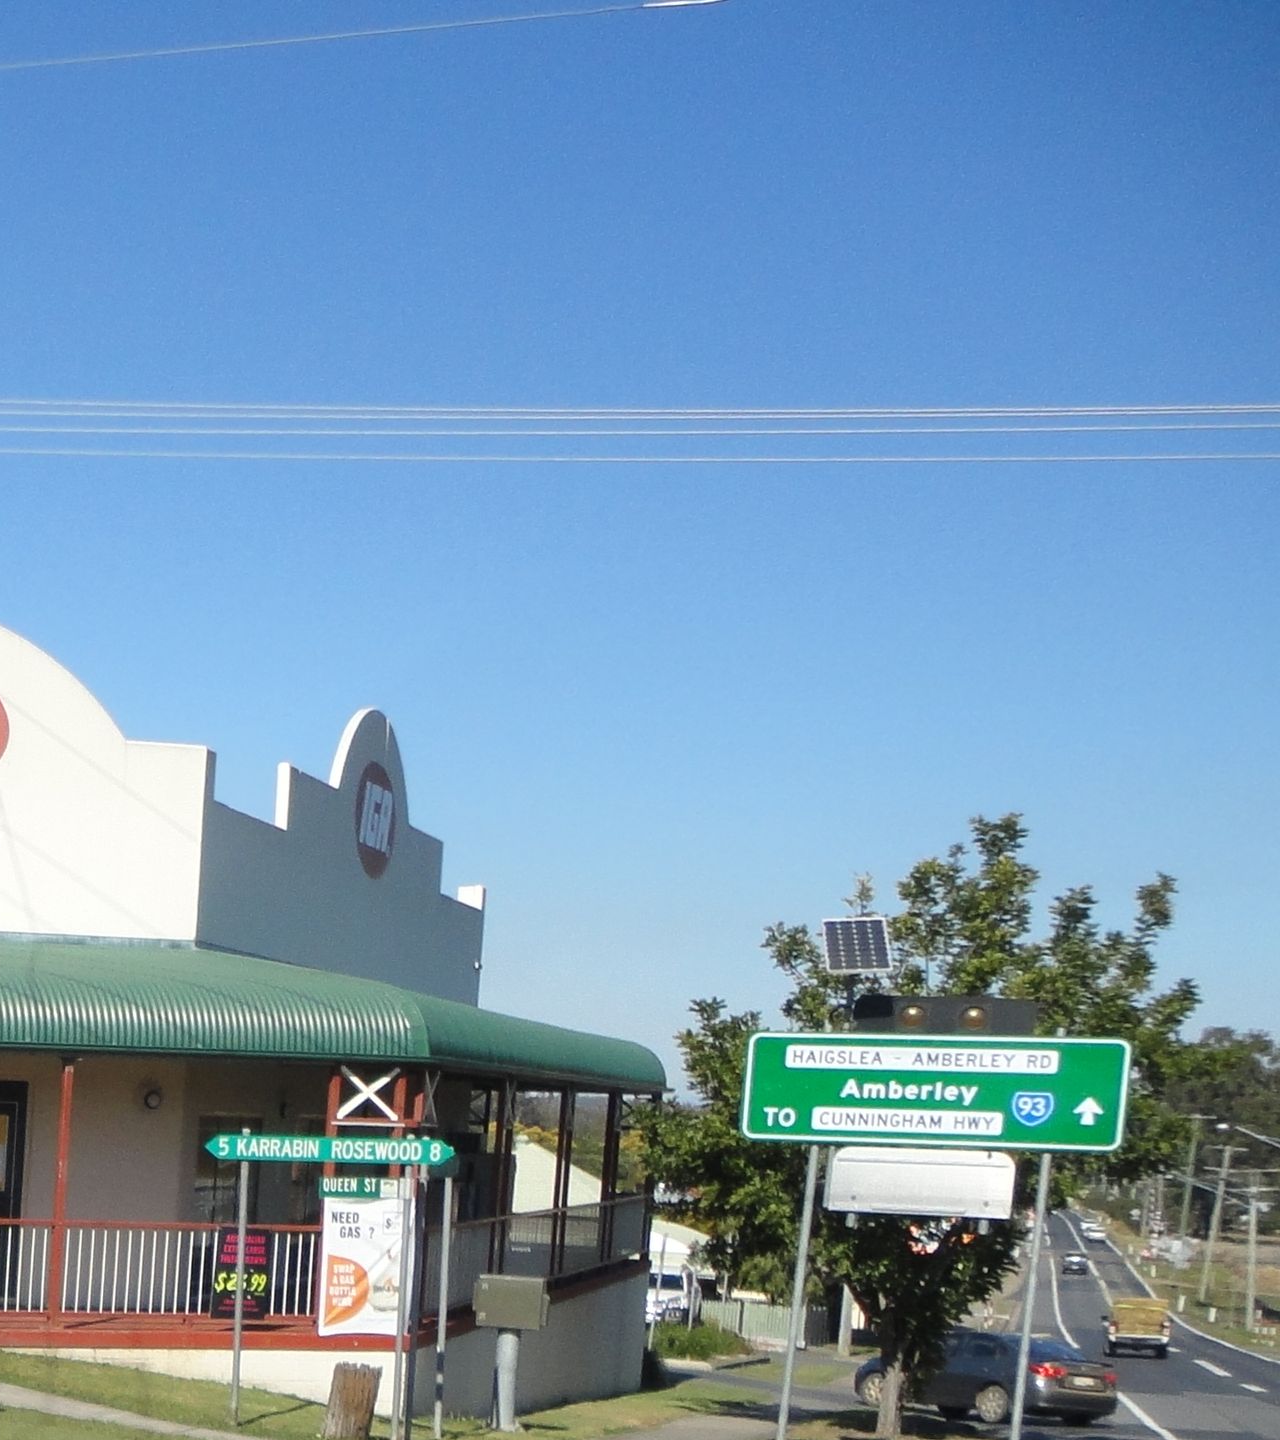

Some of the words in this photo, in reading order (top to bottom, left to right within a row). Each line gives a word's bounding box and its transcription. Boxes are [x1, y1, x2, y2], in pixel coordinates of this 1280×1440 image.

[359, 781, 393, 856] IGA
[792, 1050, 883, 1065] HAIGSLEA
[912, 1053, 1016, 1068] AMBERLEY
[1026, 1055, 1052, 1069] RD
[839, 1078, 979, 1106] Amberley
[1017, 1097, 1047, 1117] 93
[763, 1107, 797, 1128] TO
[819, 1111, 942, 1129] CUNNINGHAM
[954, 1115, 996, 1131] HWY
[218, 1138, 229, 1156] 5
[236, 1138, 319, 1159] KARRABIN
[331, 1139, 421, 1161] ROSEWOOD
[430, 1143, 441, 1161] 8
[323, 1178, 357, 1193] QUEEN
[364, 1178, 377, 1192] ST
[331, 1211, 360, 1224] NEED
[339, 1227, 361, 1239] GAS
[369, 1227, 375, 1239] ?
